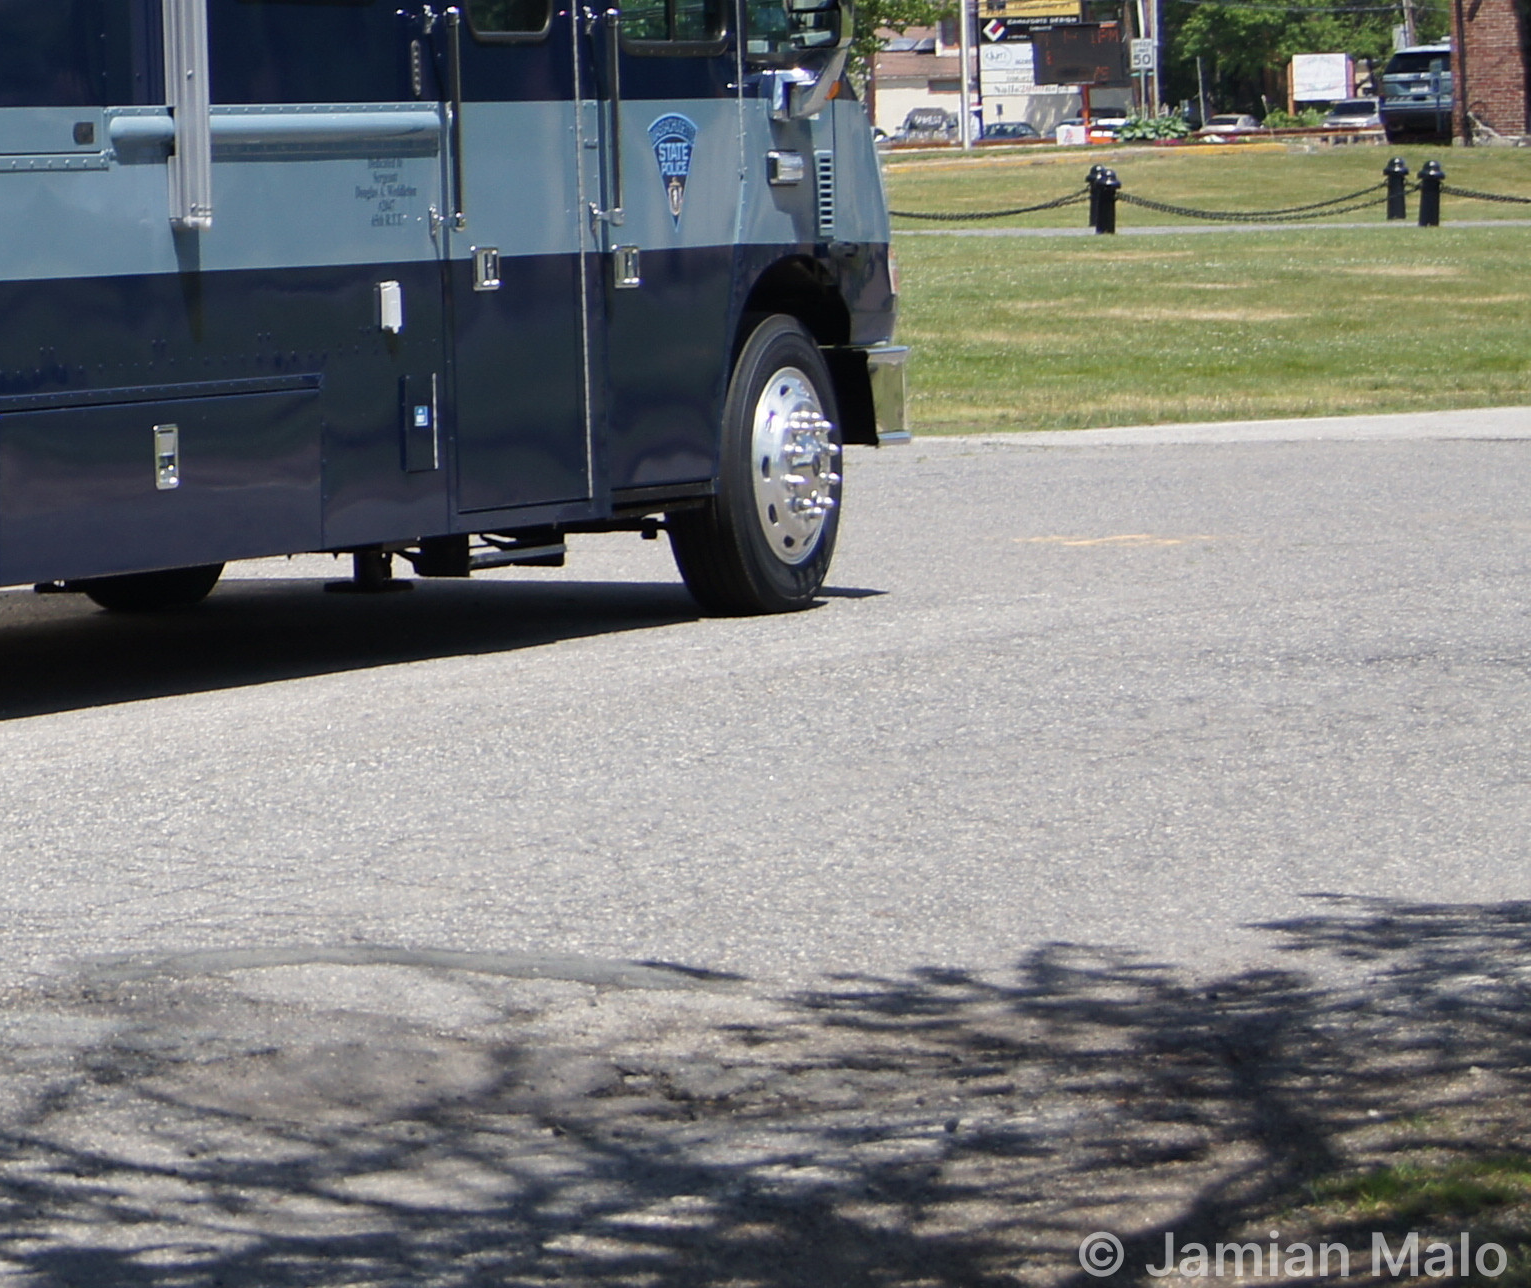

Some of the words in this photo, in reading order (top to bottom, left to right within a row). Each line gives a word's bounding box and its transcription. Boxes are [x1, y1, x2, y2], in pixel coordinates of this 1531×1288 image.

[1133, 53, 1151, 66] 50
[659, 142, 689, 161] STATE
[661, 161, 688, 176] POLICE
